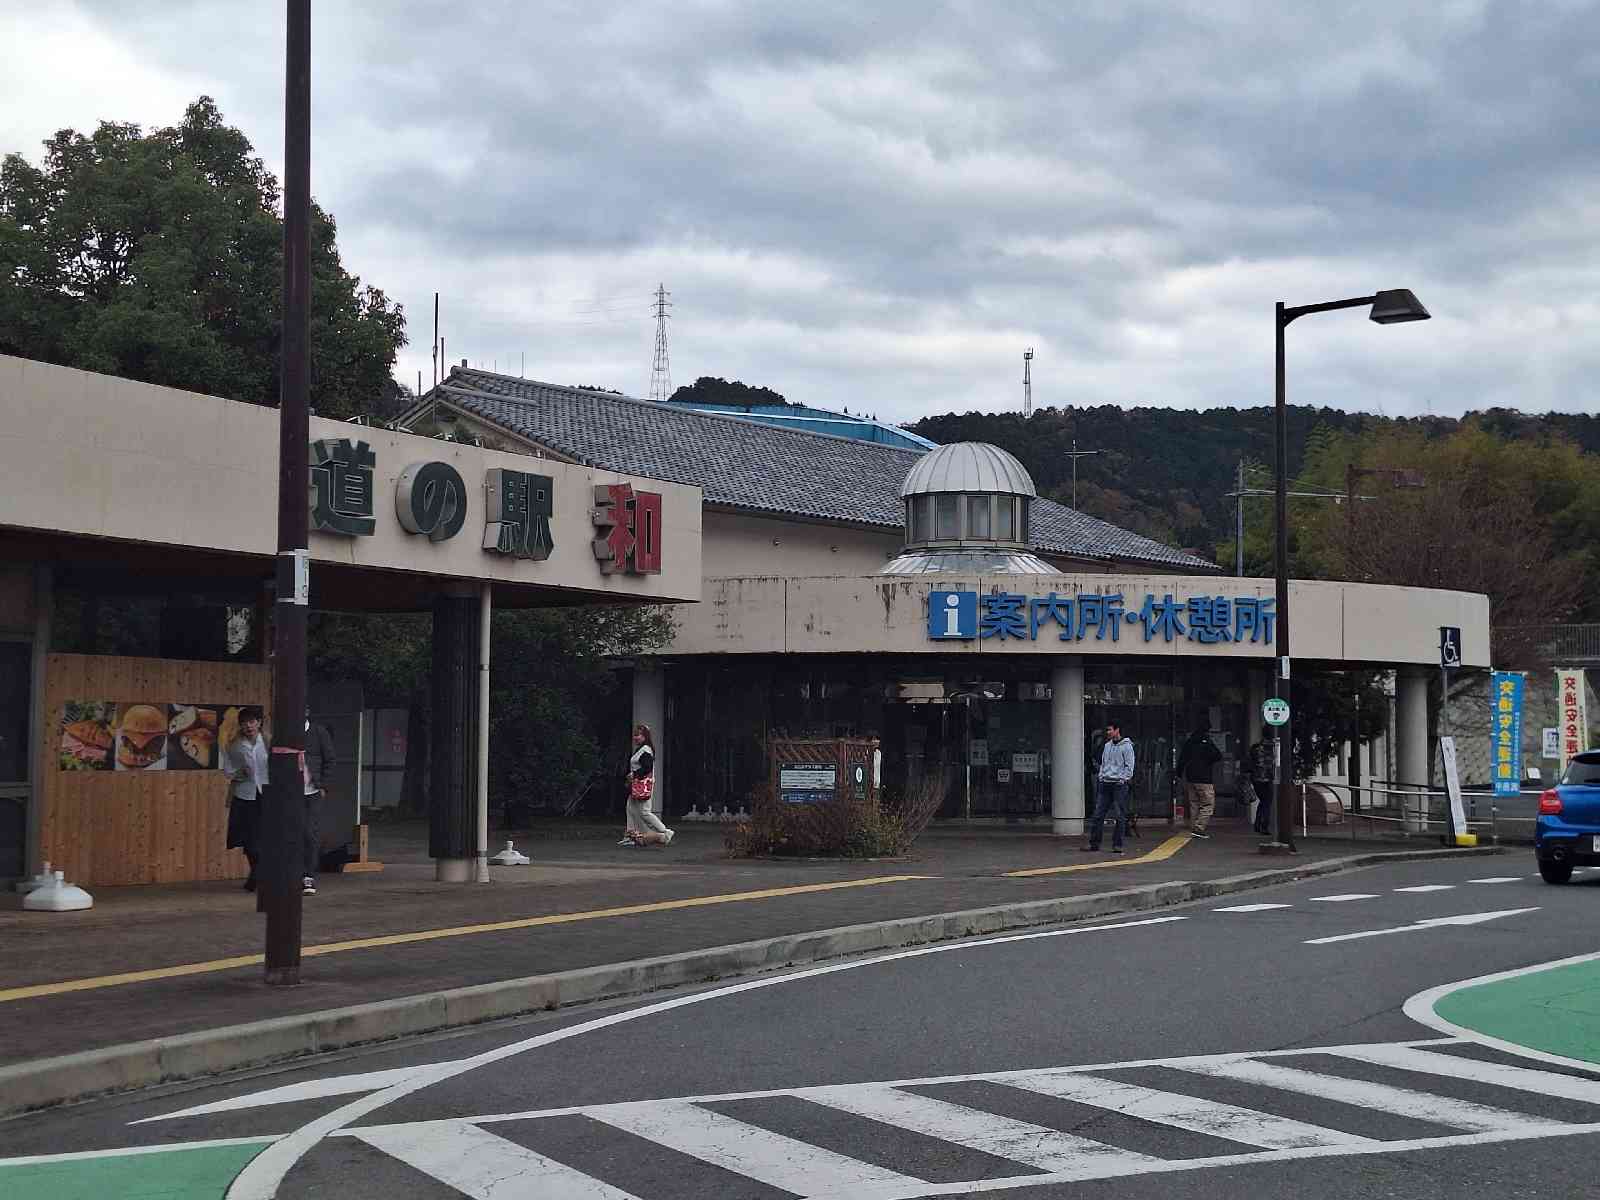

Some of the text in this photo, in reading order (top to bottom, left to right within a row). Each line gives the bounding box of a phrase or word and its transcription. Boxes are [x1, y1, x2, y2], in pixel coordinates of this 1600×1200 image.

[308, 438, 554, 561] 道の駅
[980, 592, 1276, 644] 案内所・休憩所
[1565, 676, 1579, 768] 交通安全
